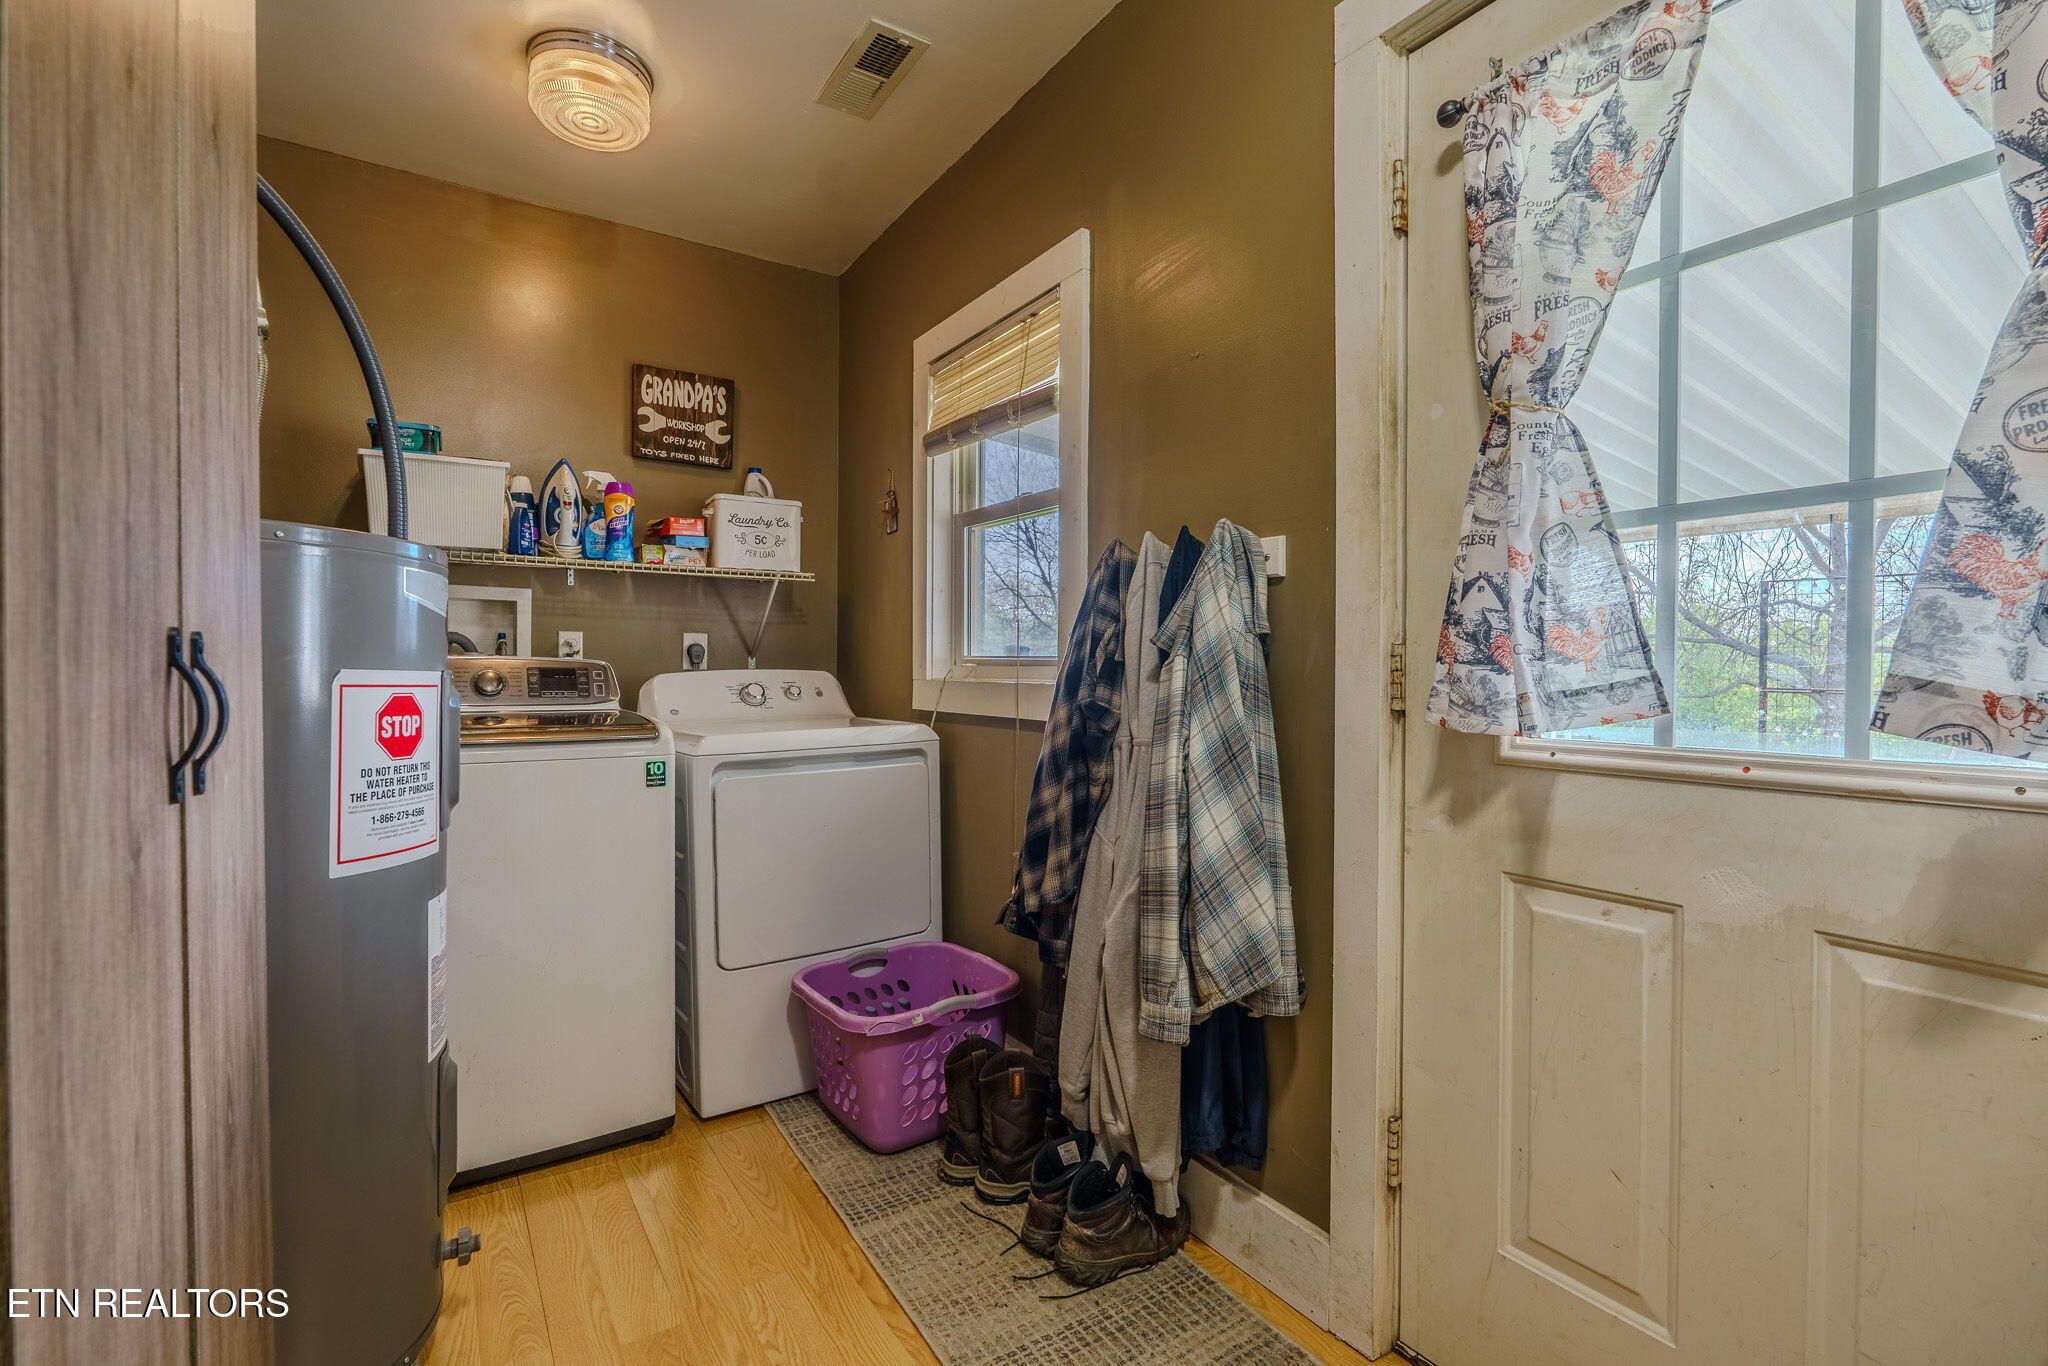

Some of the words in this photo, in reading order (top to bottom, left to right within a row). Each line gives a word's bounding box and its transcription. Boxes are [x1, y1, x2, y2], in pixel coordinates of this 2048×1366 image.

[1574, 59, 1620, 96] FRESH
[1534, 294, 1570, 322] FRES
[1484, 309, 1511, 331] RESH
[641, 374, 727, 416] GRANDPA'S
[2019, 398, 2048, 421] FRE
[666, 418, 705, 433] WORKSHOP
[2012, 420, 2048, 441] PRO
[663, 435, 685, 445] OPEN
[687, 438, 706, 450] 24/7
[640, 447, 668, 458] TOYS
[670, 451, 696, 461] FIXED
[699, 454, 719, 465] HERE
[728, 513, 774, 529] Laundry
[775, 516, 792, 529] Co.
[745, 549, 757, 558] PER
[760, 551, 776, 559] LOAD
[381, 715, 420, 738] STOP
[360, 768, 373, 779] DO
[375, 766, 391, 777] NOT
[393, 763, 418, 775] RETURN
[420, 761, 430, 770] THIS
[648, 763, 664, 775] 10
[366, 777, 394, 789] WATER
[396, 774, 420, 786] HEATER
[421, 772, 428, 781] TO
[350, 792, 367, 803] THE
[370, 788, 395, 801] PLACE
[398, 787, 407, 797] OF
[408, 781, 434, 795] PURCHASE
